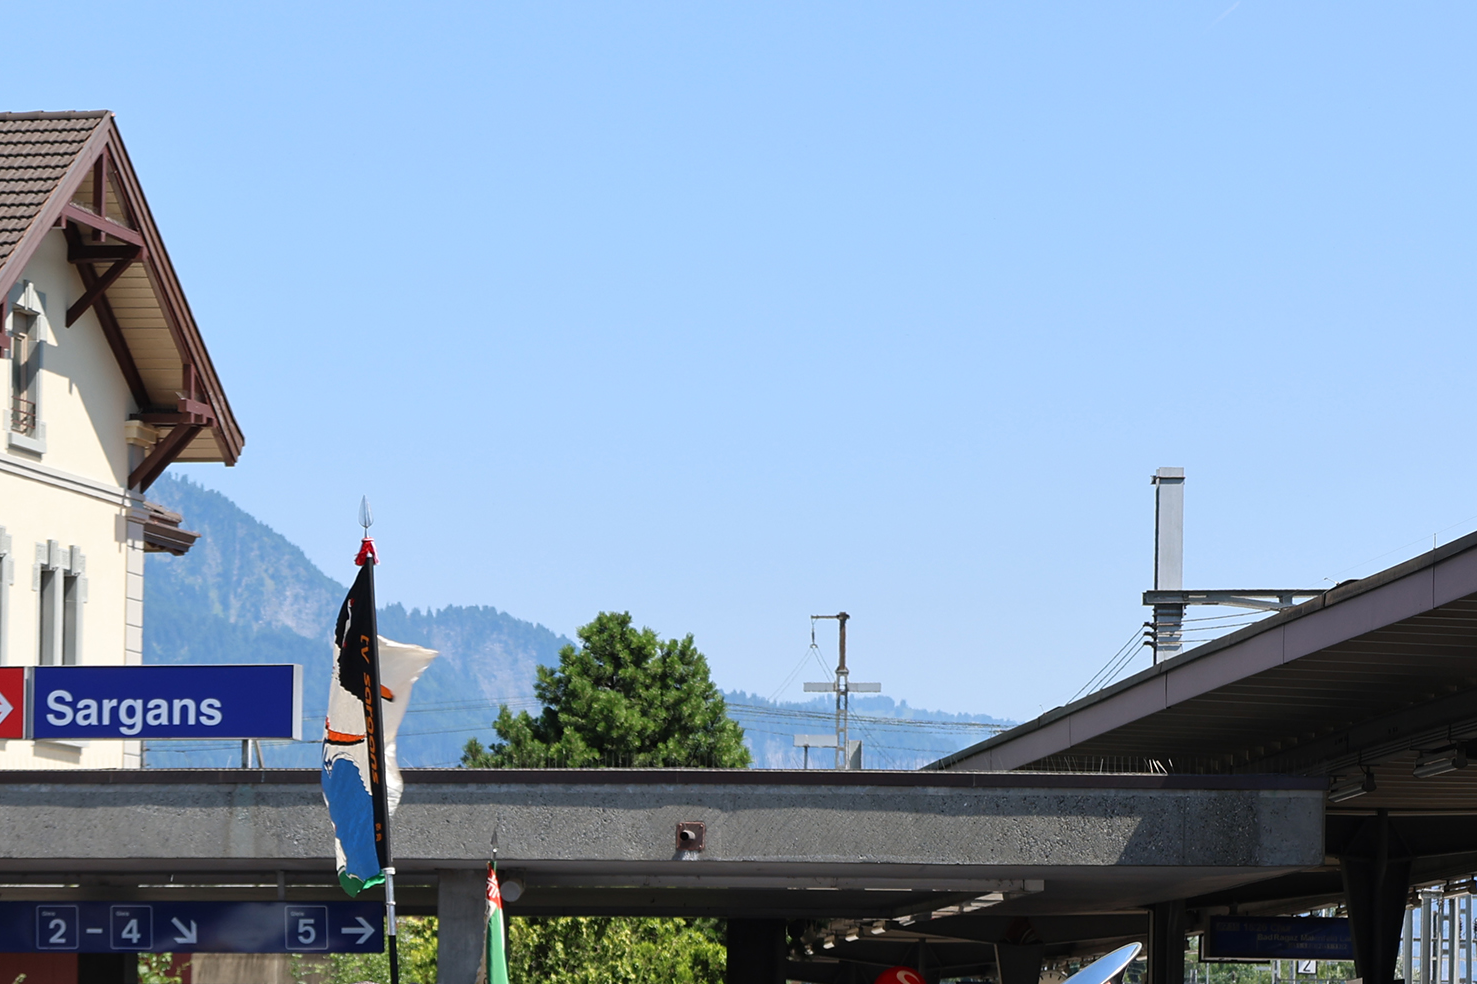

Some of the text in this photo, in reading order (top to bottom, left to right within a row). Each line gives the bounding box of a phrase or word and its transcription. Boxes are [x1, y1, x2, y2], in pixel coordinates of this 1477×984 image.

[46, 689, 222, 736] Sargans
[48, 918, 67, 943] 2
[121, 918, 141, 944] 4
[297, 918, 316, 944] 5
[1257, 933, 1273, 942] Bad
[1274, 934, 1298, 943] Ragaz
[1303, 960, 1312, 972] 2
